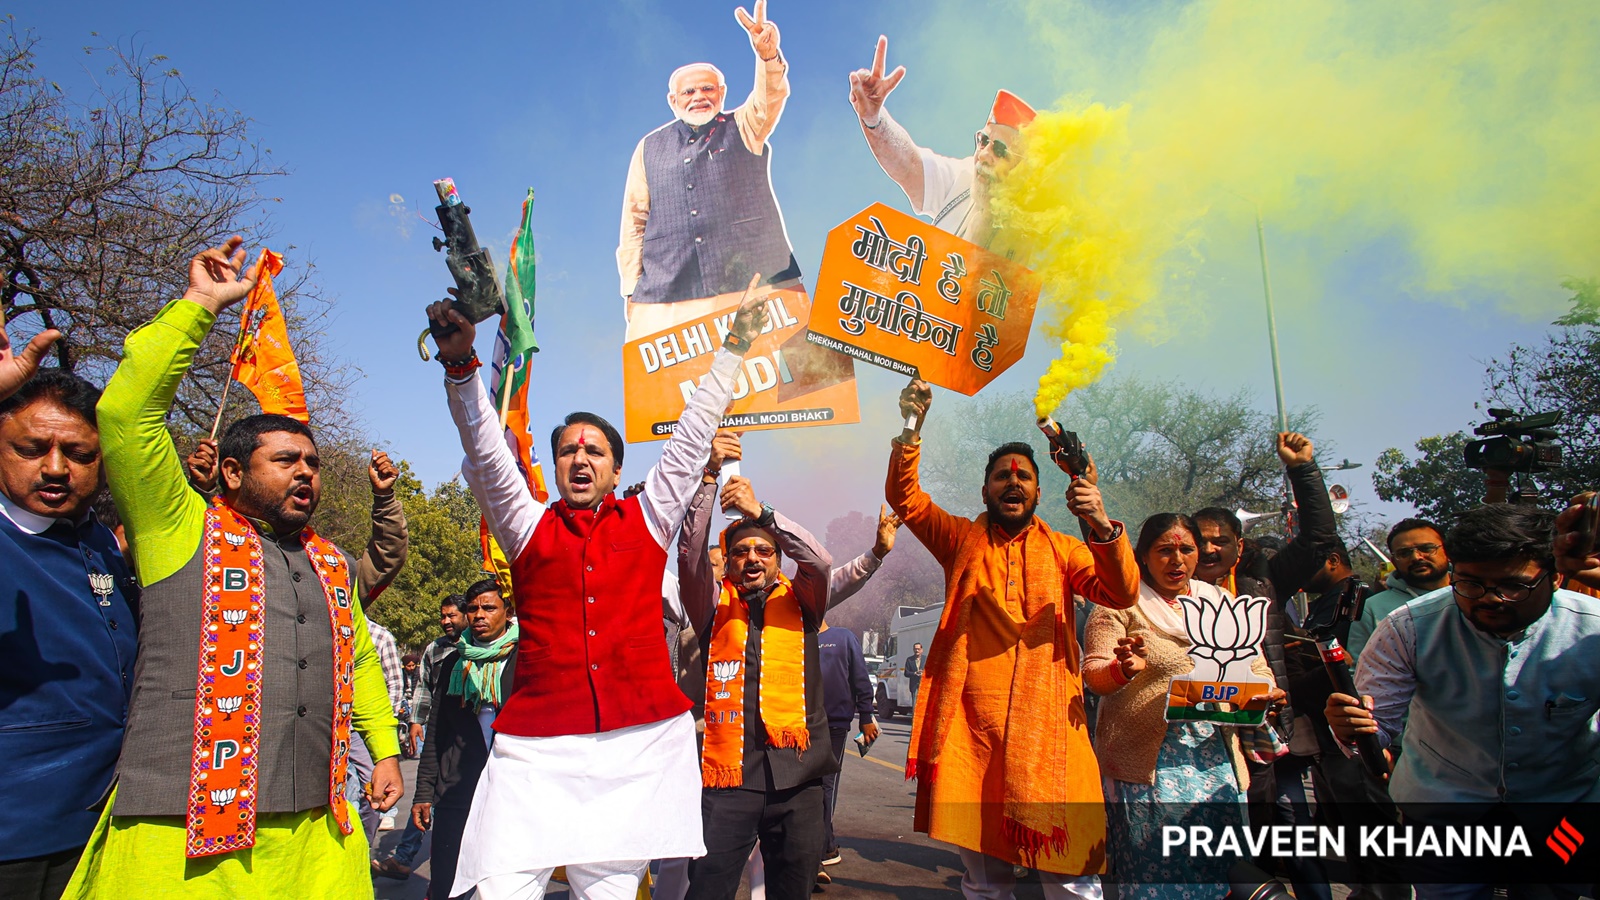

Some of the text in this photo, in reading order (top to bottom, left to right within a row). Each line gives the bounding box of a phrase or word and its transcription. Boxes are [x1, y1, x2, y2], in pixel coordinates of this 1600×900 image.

[852, 216, 1011, 319] मोदी है तो
[639, 323, 714, 374] DELHI
[839, 280, 998, 372] मुमकिन है
[807, 332, 916, 375] SHEKHAR CHAHAL MODI BHAKT
[720, 410, 829, 428] HAHAL MODI BHAKT
[334, 586, 349, 608] B
[212, 567, 249, 769] B J P
[1201, 684, 1239, 701] BJP
